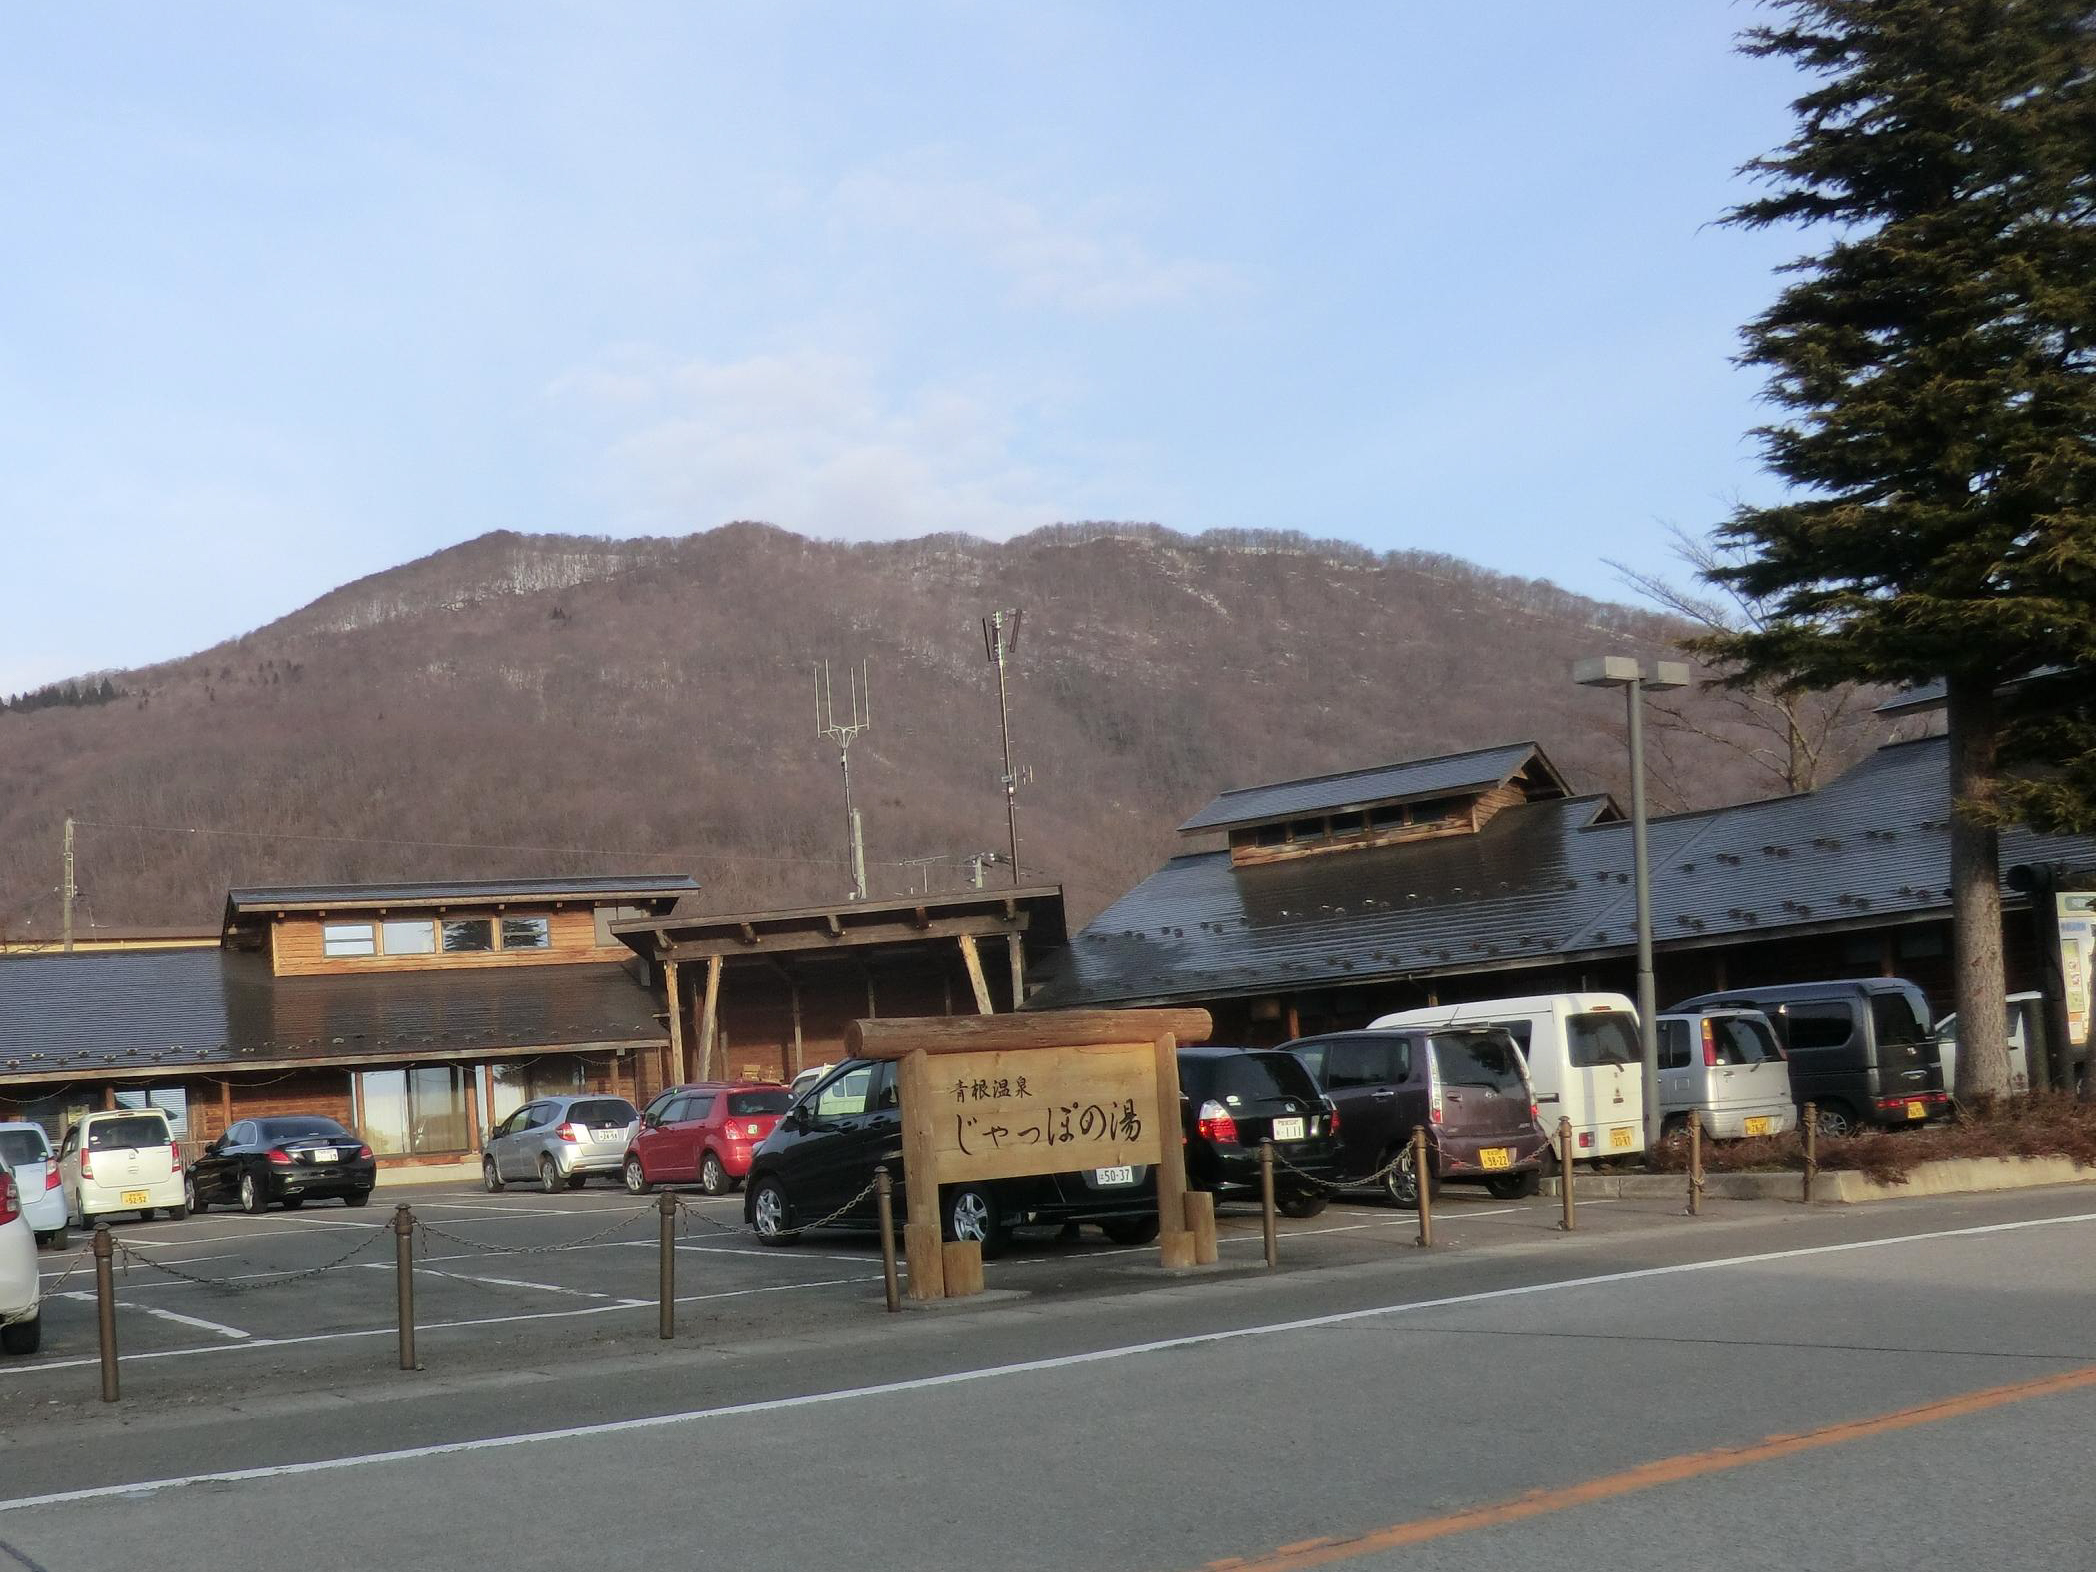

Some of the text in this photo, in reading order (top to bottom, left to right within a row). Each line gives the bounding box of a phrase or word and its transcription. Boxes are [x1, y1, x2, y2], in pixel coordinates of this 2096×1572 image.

[950, 1076, 1032, 1103] 青根温泉
[1105, 1168, 1130, 1182] 50-37
